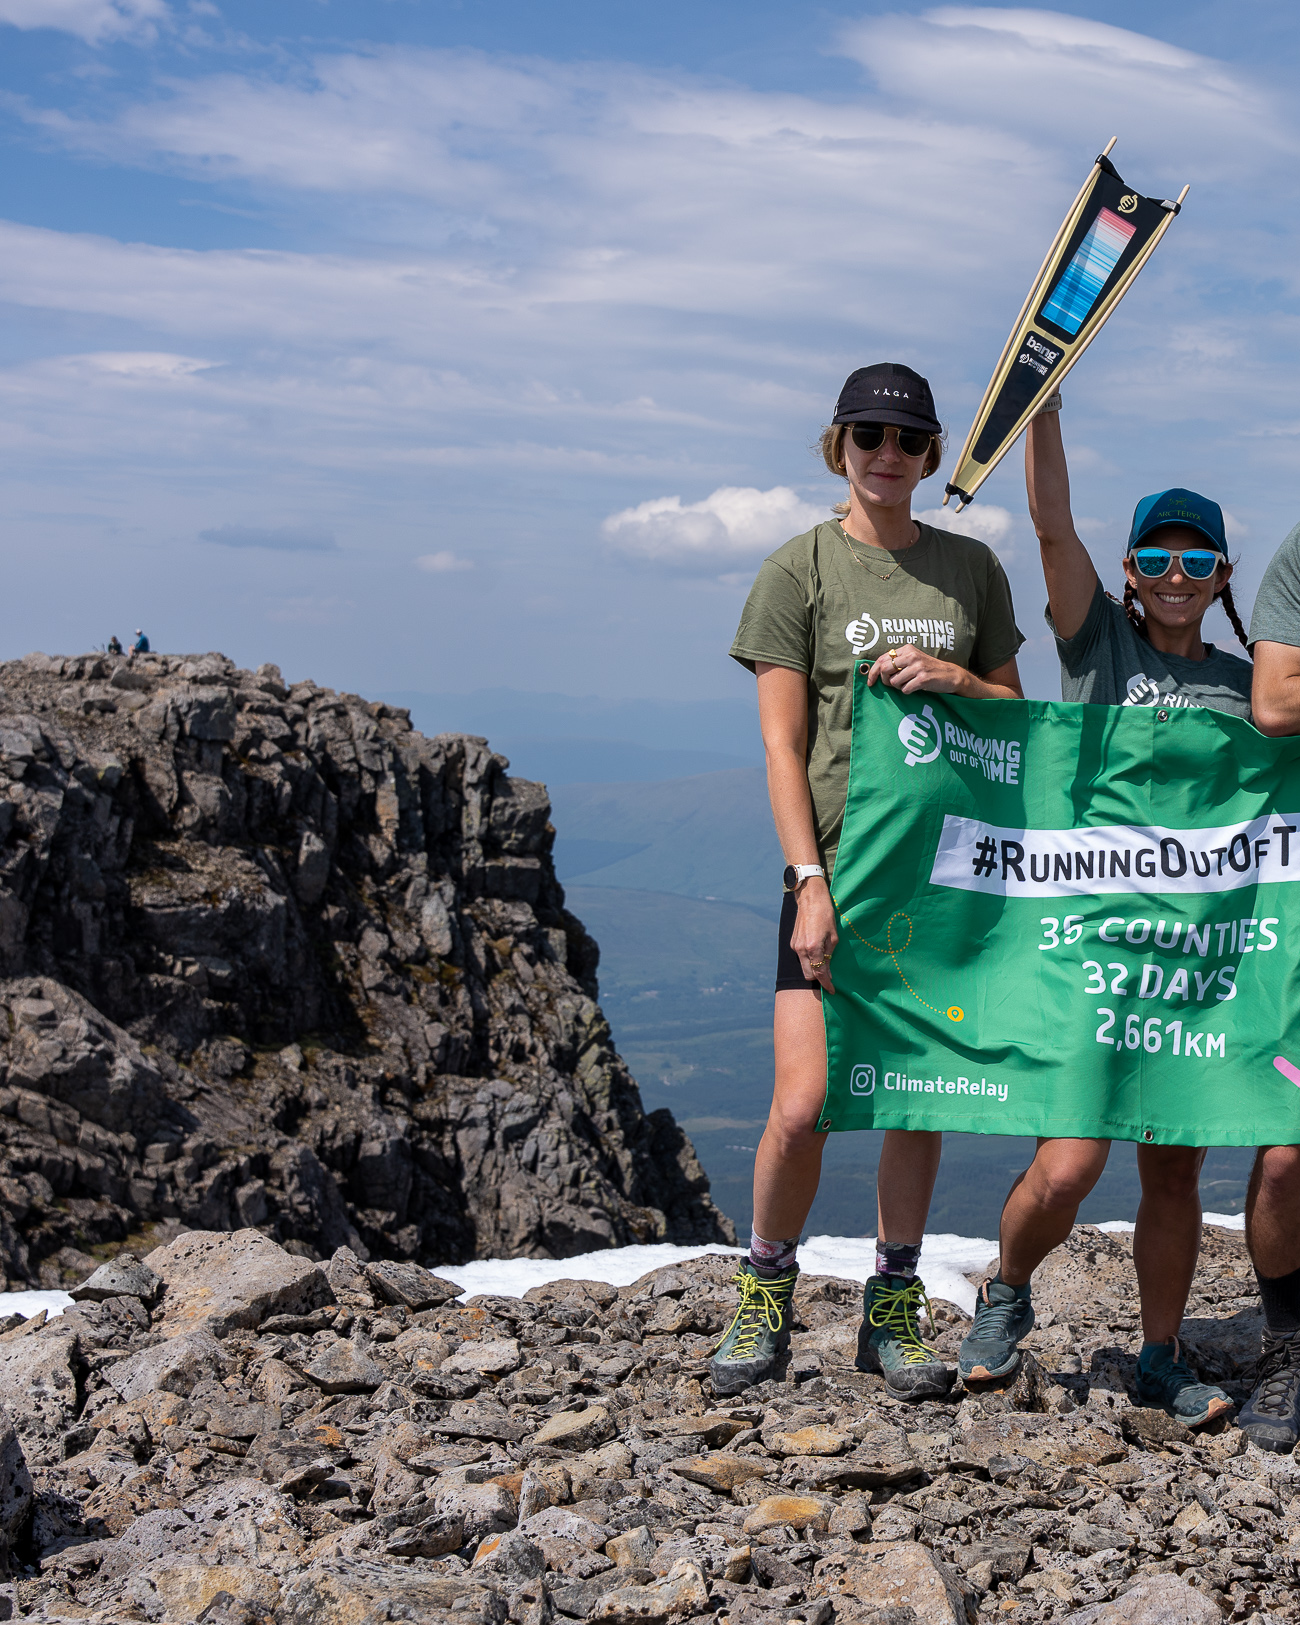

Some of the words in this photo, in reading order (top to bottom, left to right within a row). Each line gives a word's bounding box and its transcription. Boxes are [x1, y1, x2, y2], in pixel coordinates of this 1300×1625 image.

[881, 618, 955, 636] RUNNING
[886, 635, 904, 645] OUT
[906, 635, 918, 645] OF
[919, 632, 955, 650] TIME
[944, 721, 1021, 763] RUNNING
[949, 749, 967, 765] OUT
[969, 755, 979, 768] OF
[979, 757, 1020, 785] TIME
[1037, 914, 1085, 951] 35
[1097, 915, 1280, 957] COUNTIES
[1081, 960, 1129, 997] 32
[1137, 964, 1238, 1002] DAYS
[1095, 1007, 1226, 1059] 2,661KM
[883, 1071, 1009, 1102] ClimateRelay
